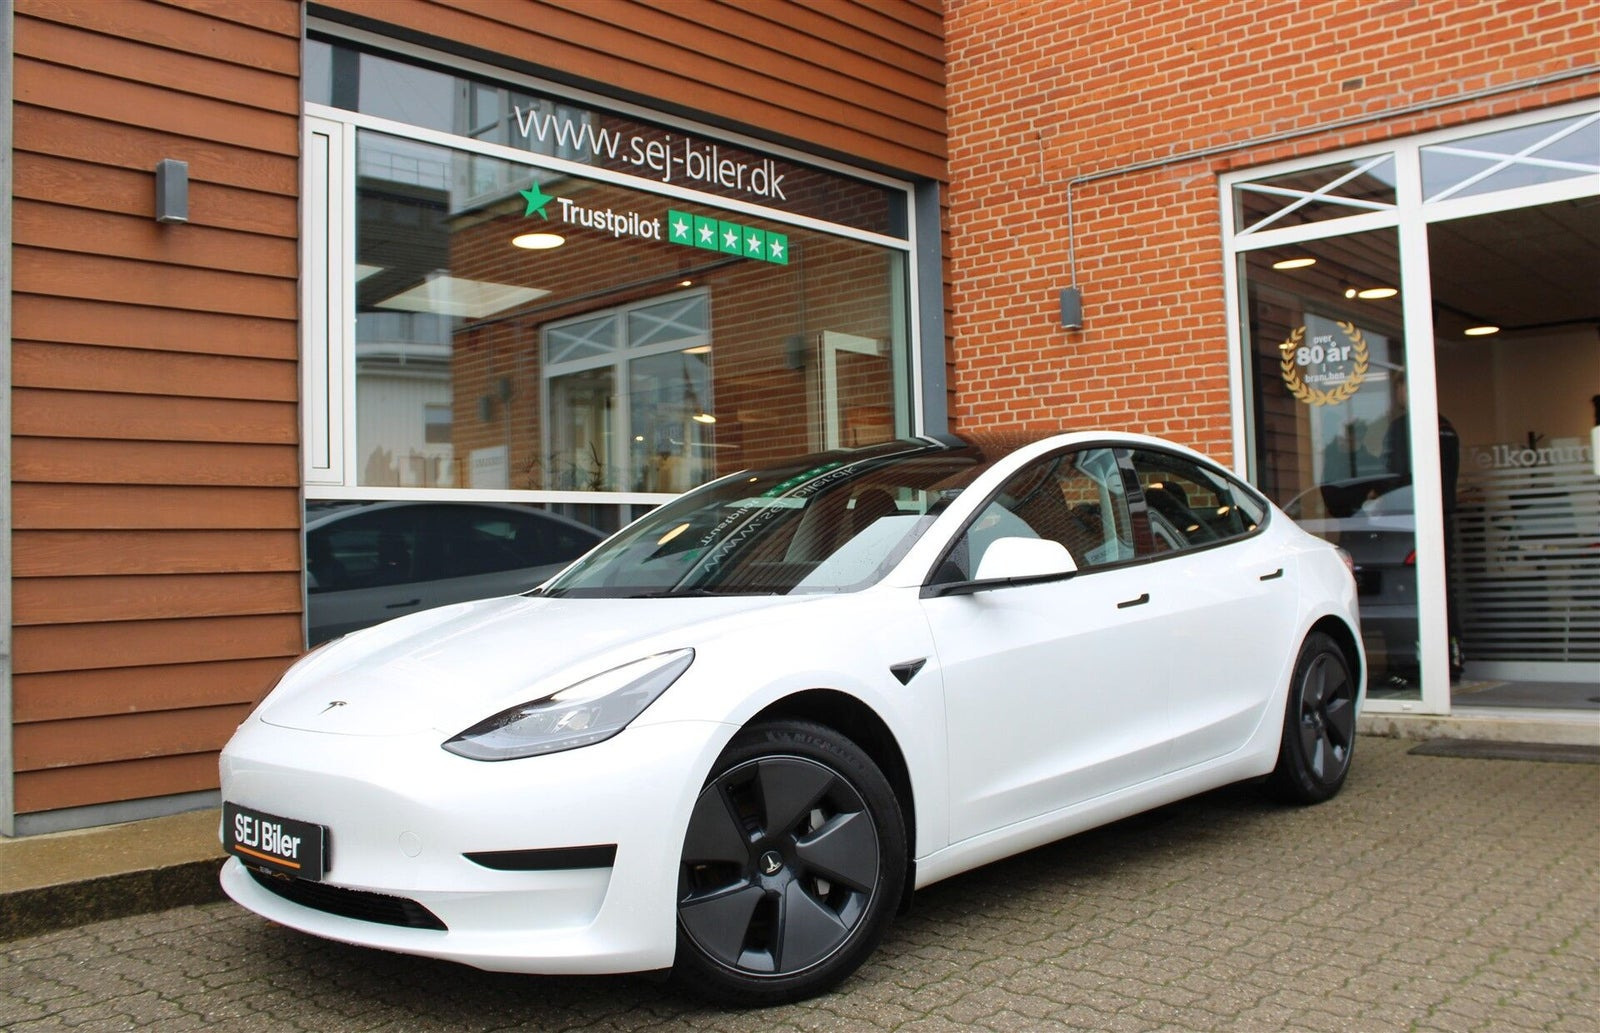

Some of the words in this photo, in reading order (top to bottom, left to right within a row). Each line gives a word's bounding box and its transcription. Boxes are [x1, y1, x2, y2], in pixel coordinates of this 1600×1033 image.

[514, 105, 787, 201] www.sej-biler.dk
[557, 197, 661, 240] Trustpilot
[1296, 344, 1325, 366] 80
[1326, 341, 1351, 363] år
[1313, 334, 1333, 344] over
[234, 813, 259, 847] SEJ
[261, 821, 301, 859] Biler
